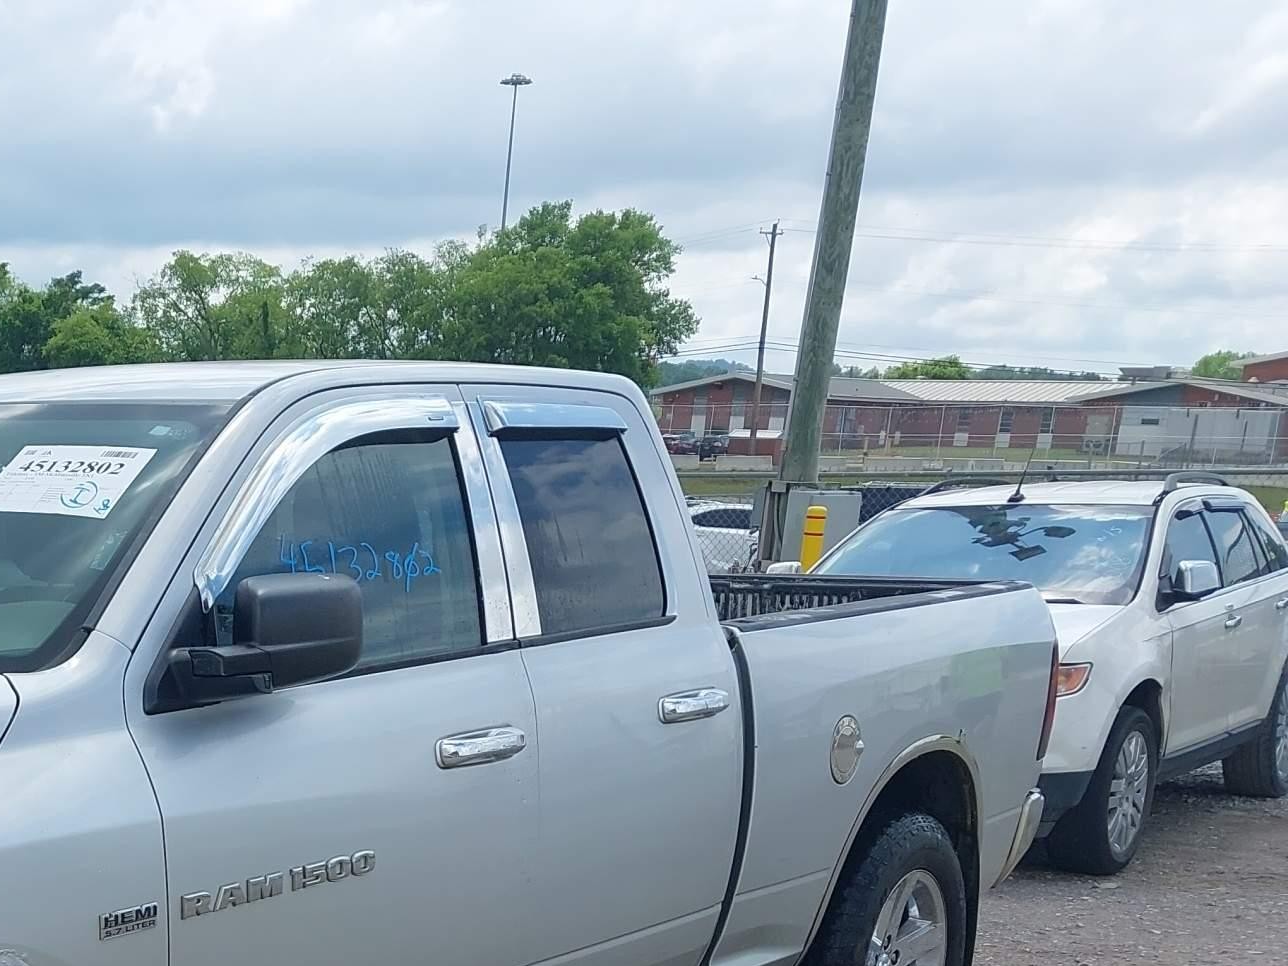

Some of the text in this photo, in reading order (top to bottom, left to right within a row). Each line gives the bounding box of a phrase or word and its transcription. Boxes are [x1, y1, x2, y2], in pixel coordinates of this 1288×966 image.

[17, 460, 125, 475] 45132802
[180, 849, 376, 920] RAM 1500
[102, 902, 159, 929] HEMI
[124, 919, 156, 932] LITER
